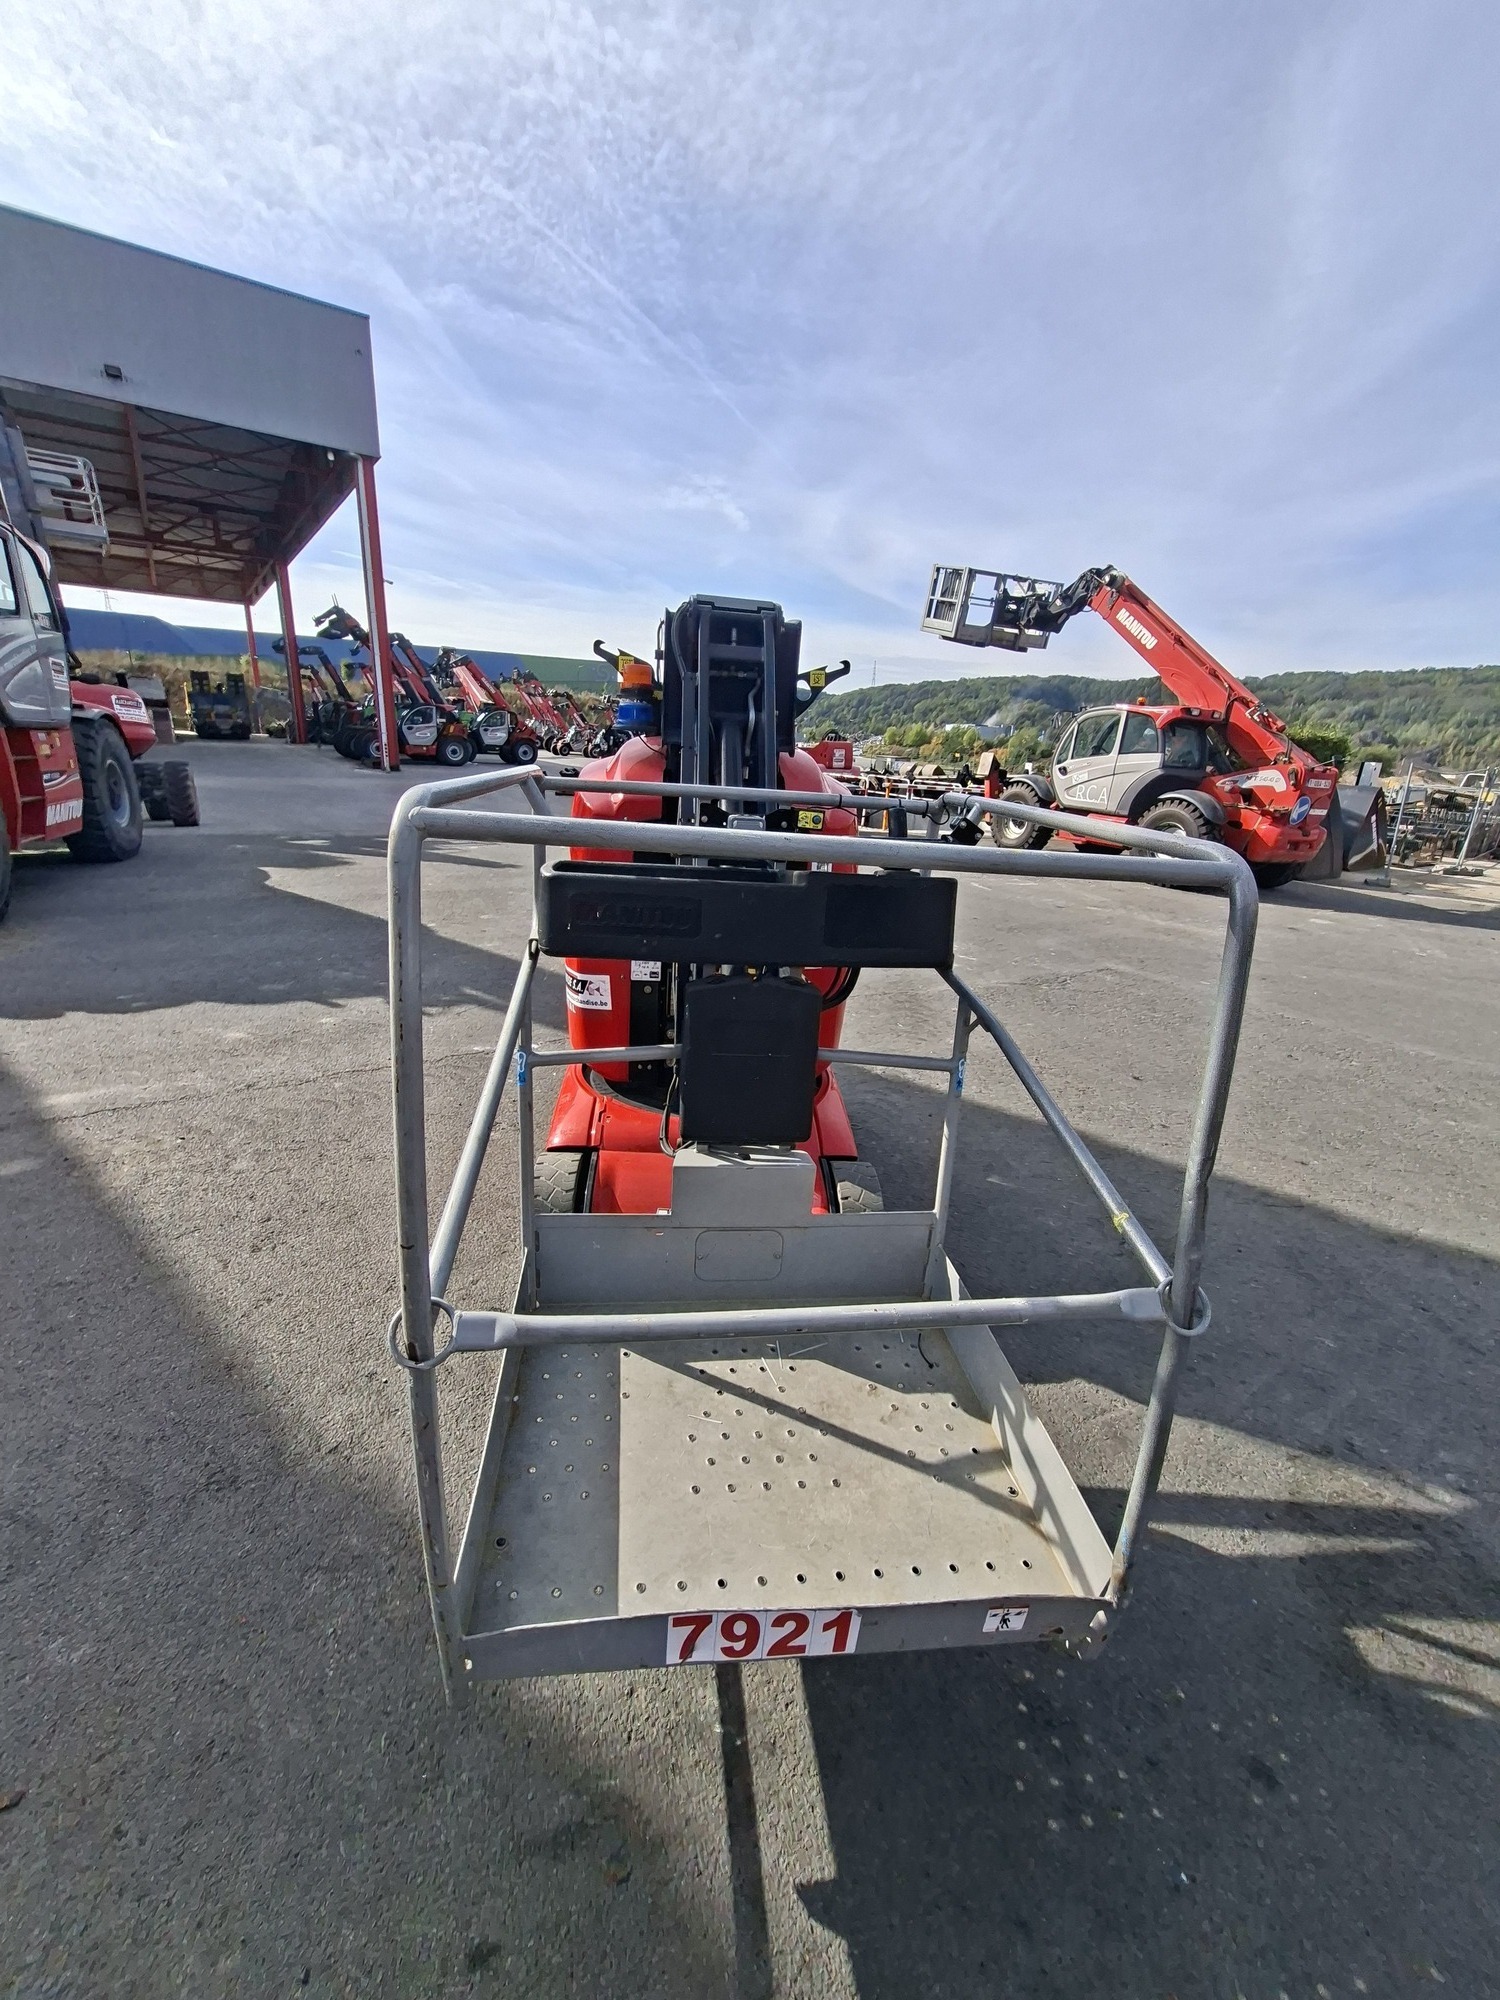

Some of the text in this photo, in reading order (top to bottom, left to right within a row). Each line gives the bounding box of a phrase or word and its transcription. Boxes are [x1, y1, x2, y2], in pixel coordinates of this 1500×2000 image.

[1115, 607, 1158, 650] MANITOU
[46, 799, 83, 827] MANITOU
[672, 1610, 854, 1660] 7921
